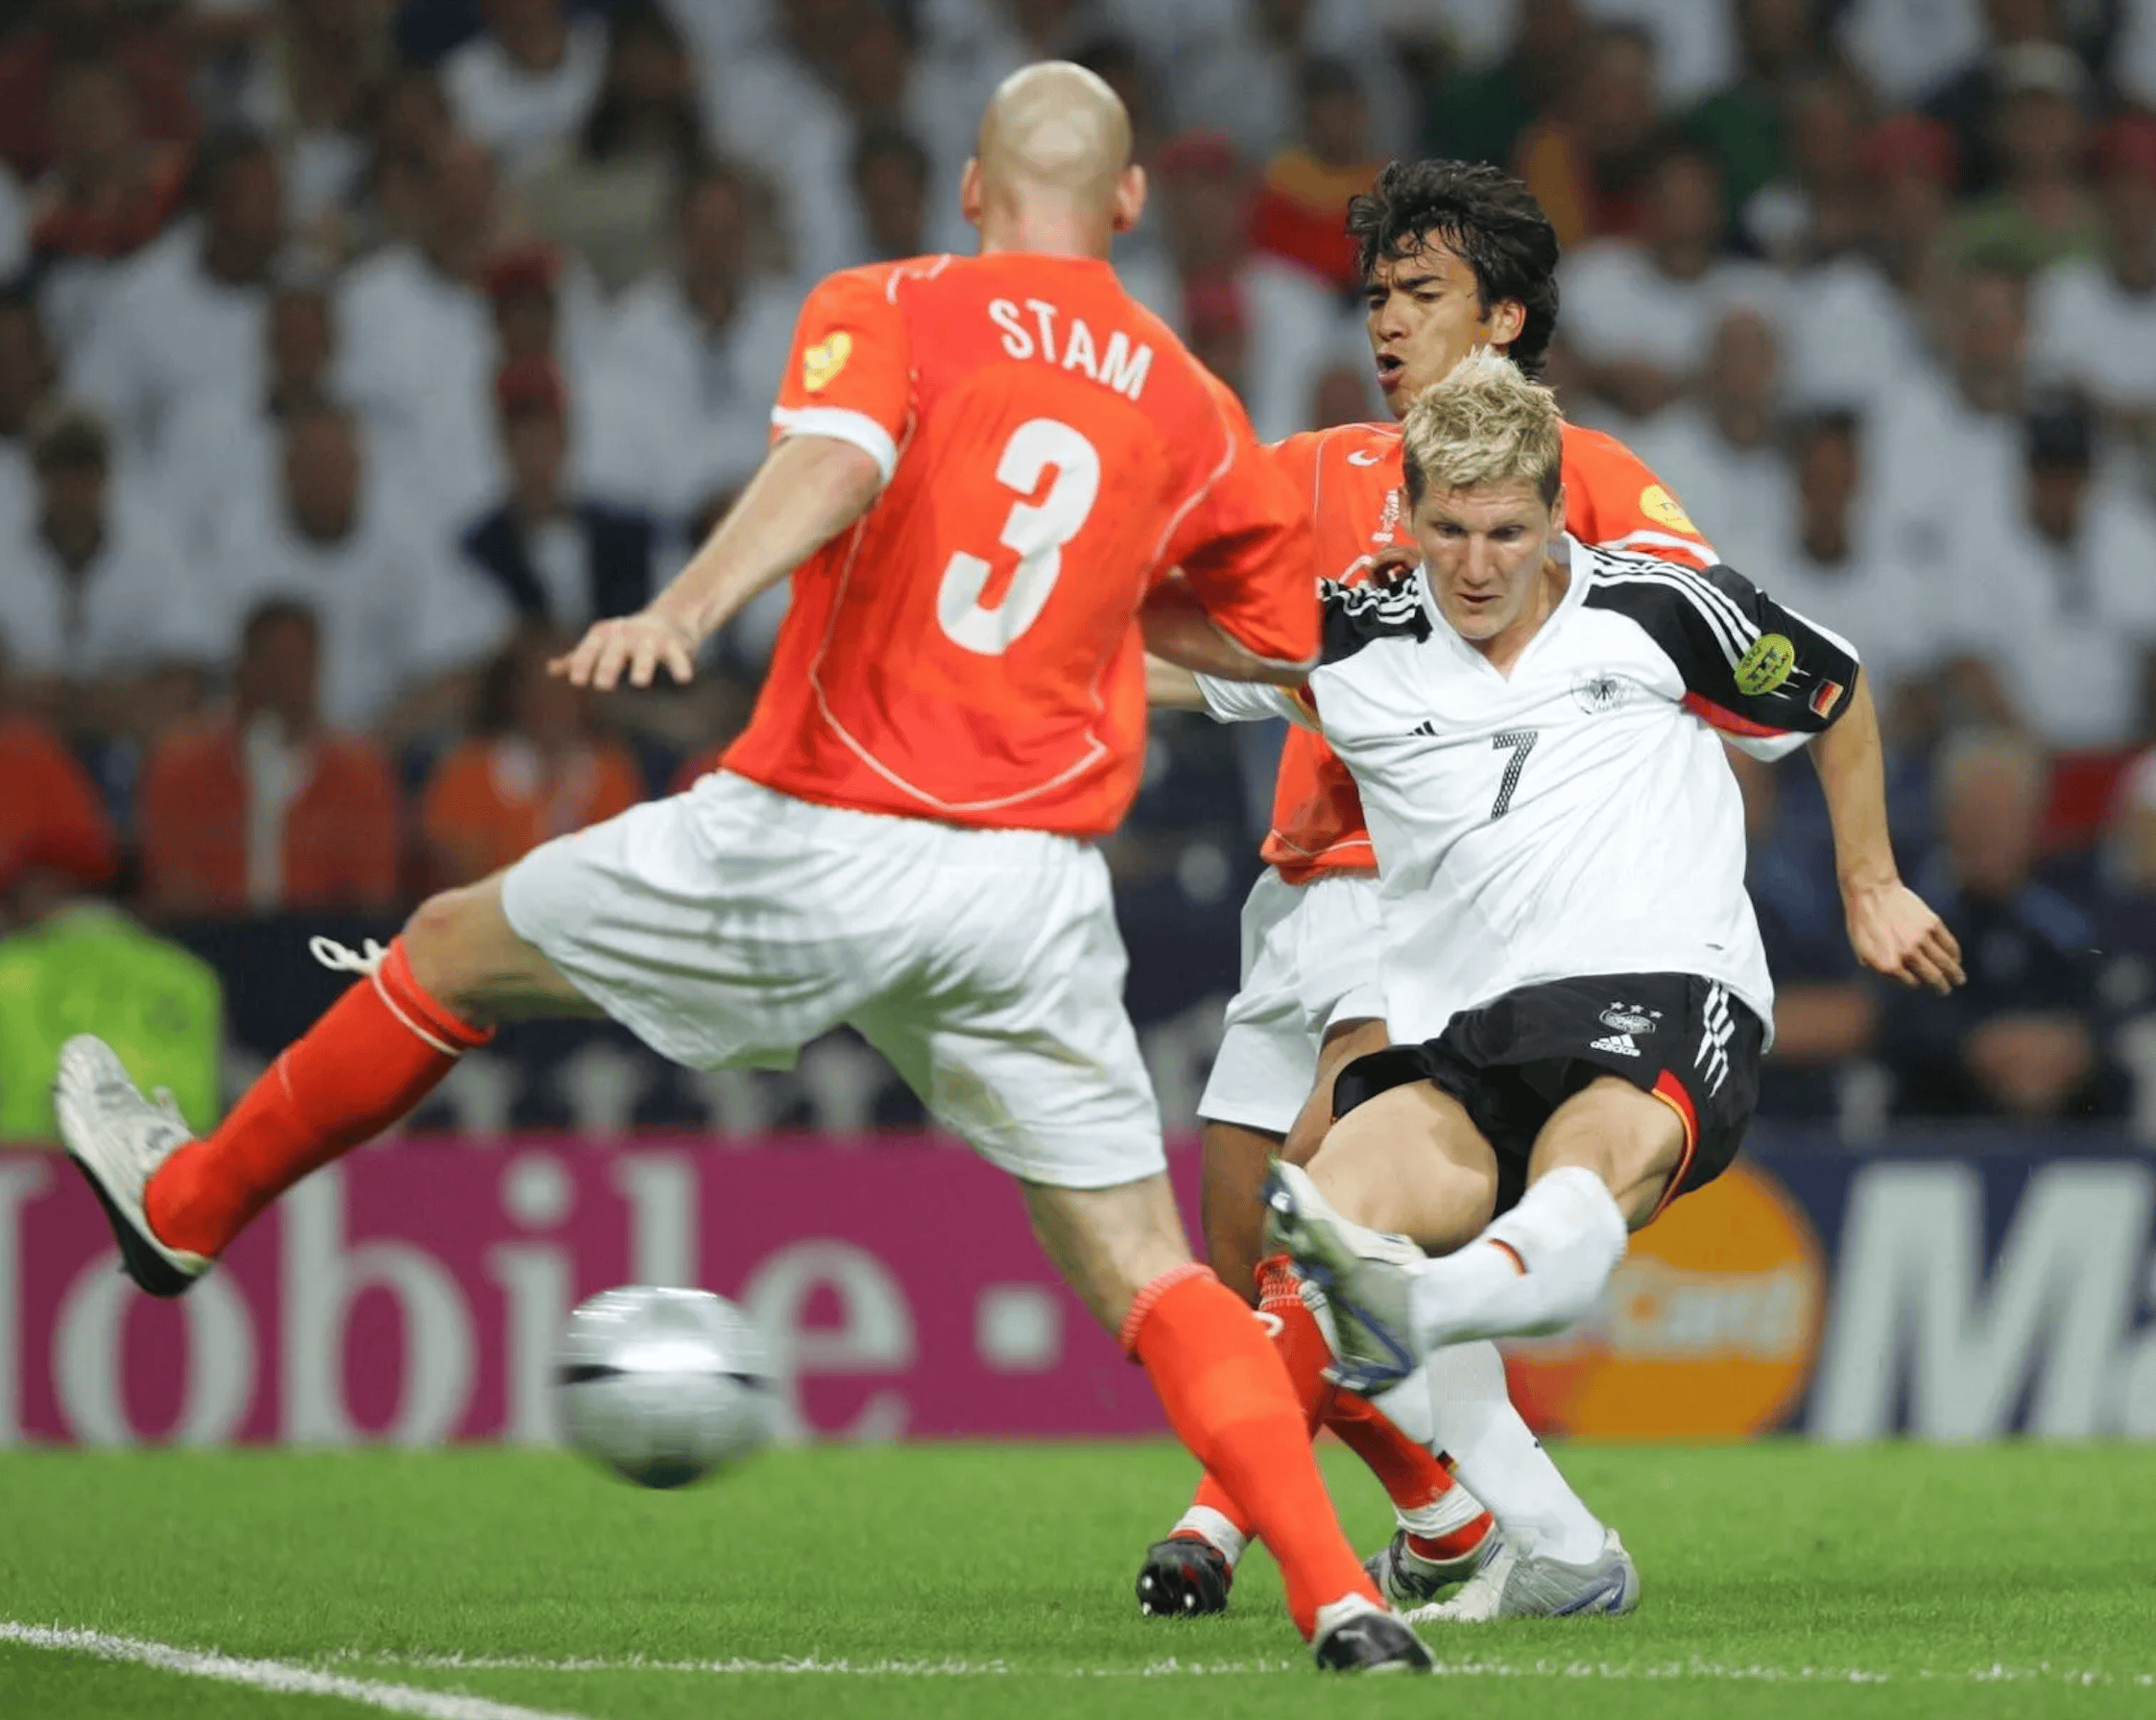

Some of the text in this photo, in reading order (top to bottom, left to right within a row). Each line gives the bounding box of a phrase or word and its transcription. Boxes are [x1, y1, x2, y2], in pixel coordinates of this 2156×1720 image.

[989, 299, 1153, 400] STAM
[936, 418, 1101, 656] 3
[1491, 731, 1538, 821] 7
[0, 1155, 916, 1451] obie
